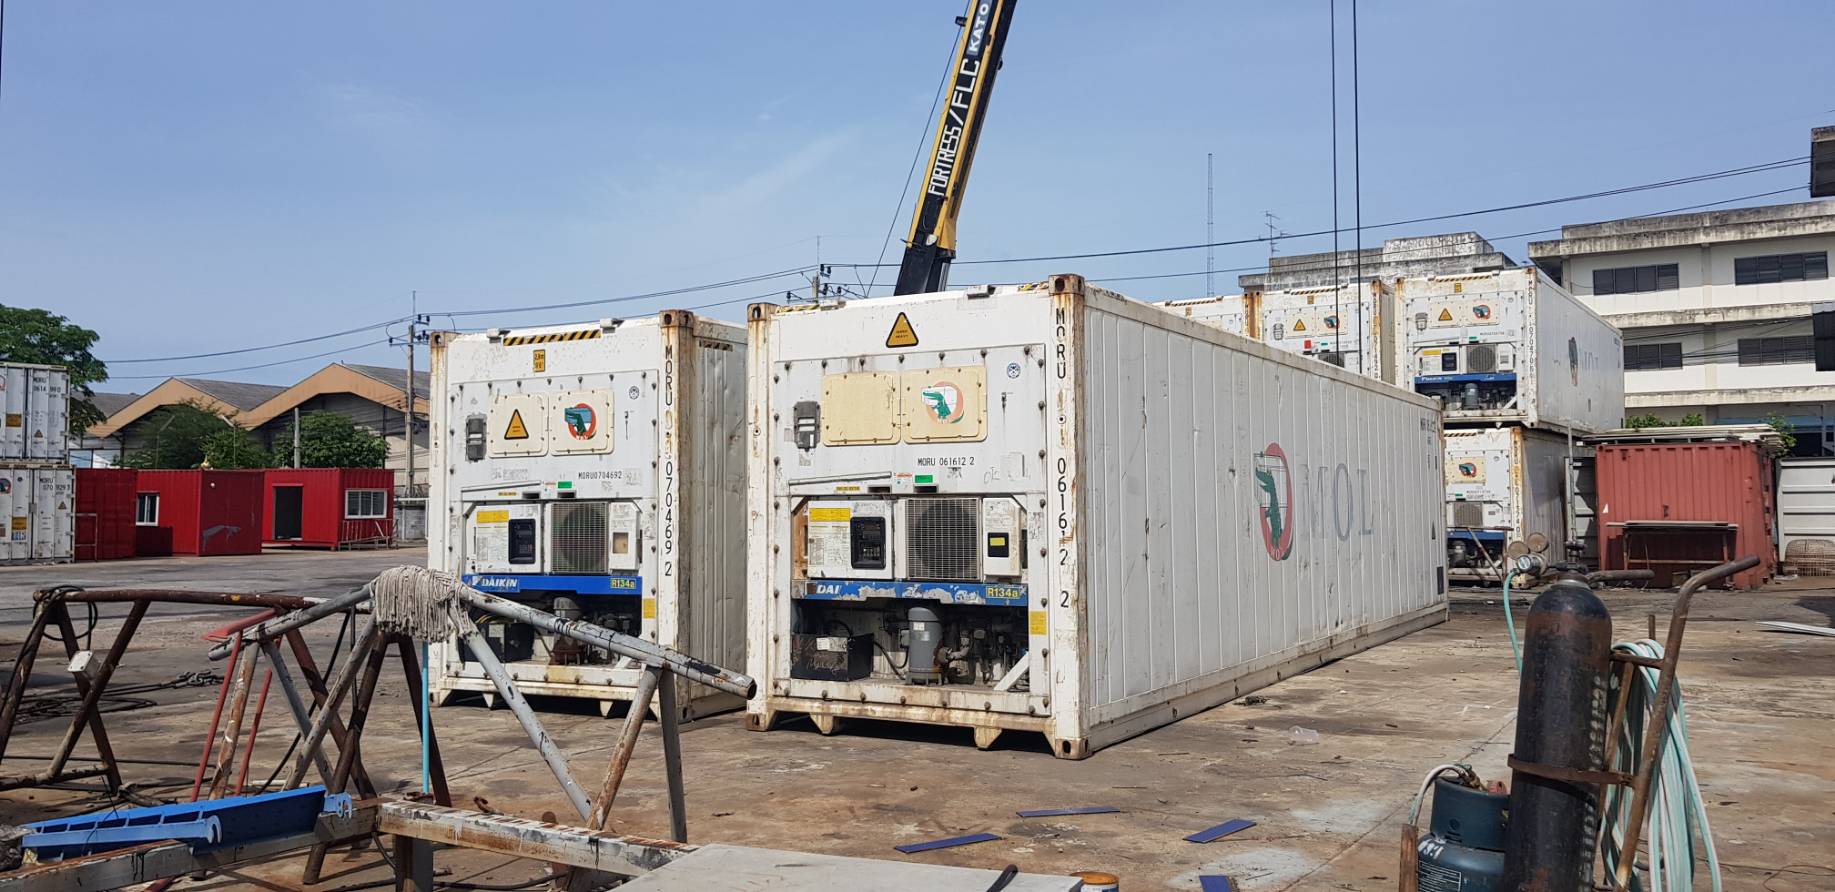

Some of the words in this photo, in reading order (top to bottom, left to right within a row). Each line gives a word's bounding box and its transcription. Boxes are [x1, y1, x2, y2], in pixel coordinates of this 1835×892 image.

[969, 3, 989, 52] KATO
[1056, 308, 1067, 380] MORU
[665, 345, 673, 406] MORU
[917, 457, 936, 466] MORU
[939, 456, 967, 466] 061612
[969, 456, 975, 465] 2
[577, 470, 622, 480] MORU0704692
[664, 461, 673, 555] 070469
[664, 562, 672, 577] 2
[481, 578, 518, 587] DAIKIN
[610, 577, 636, 589] R134a
[816, 584, 842, 594] DAI
[987, 587, 1018, 598] R134a
[1060, 590, 1070, 608] 2
